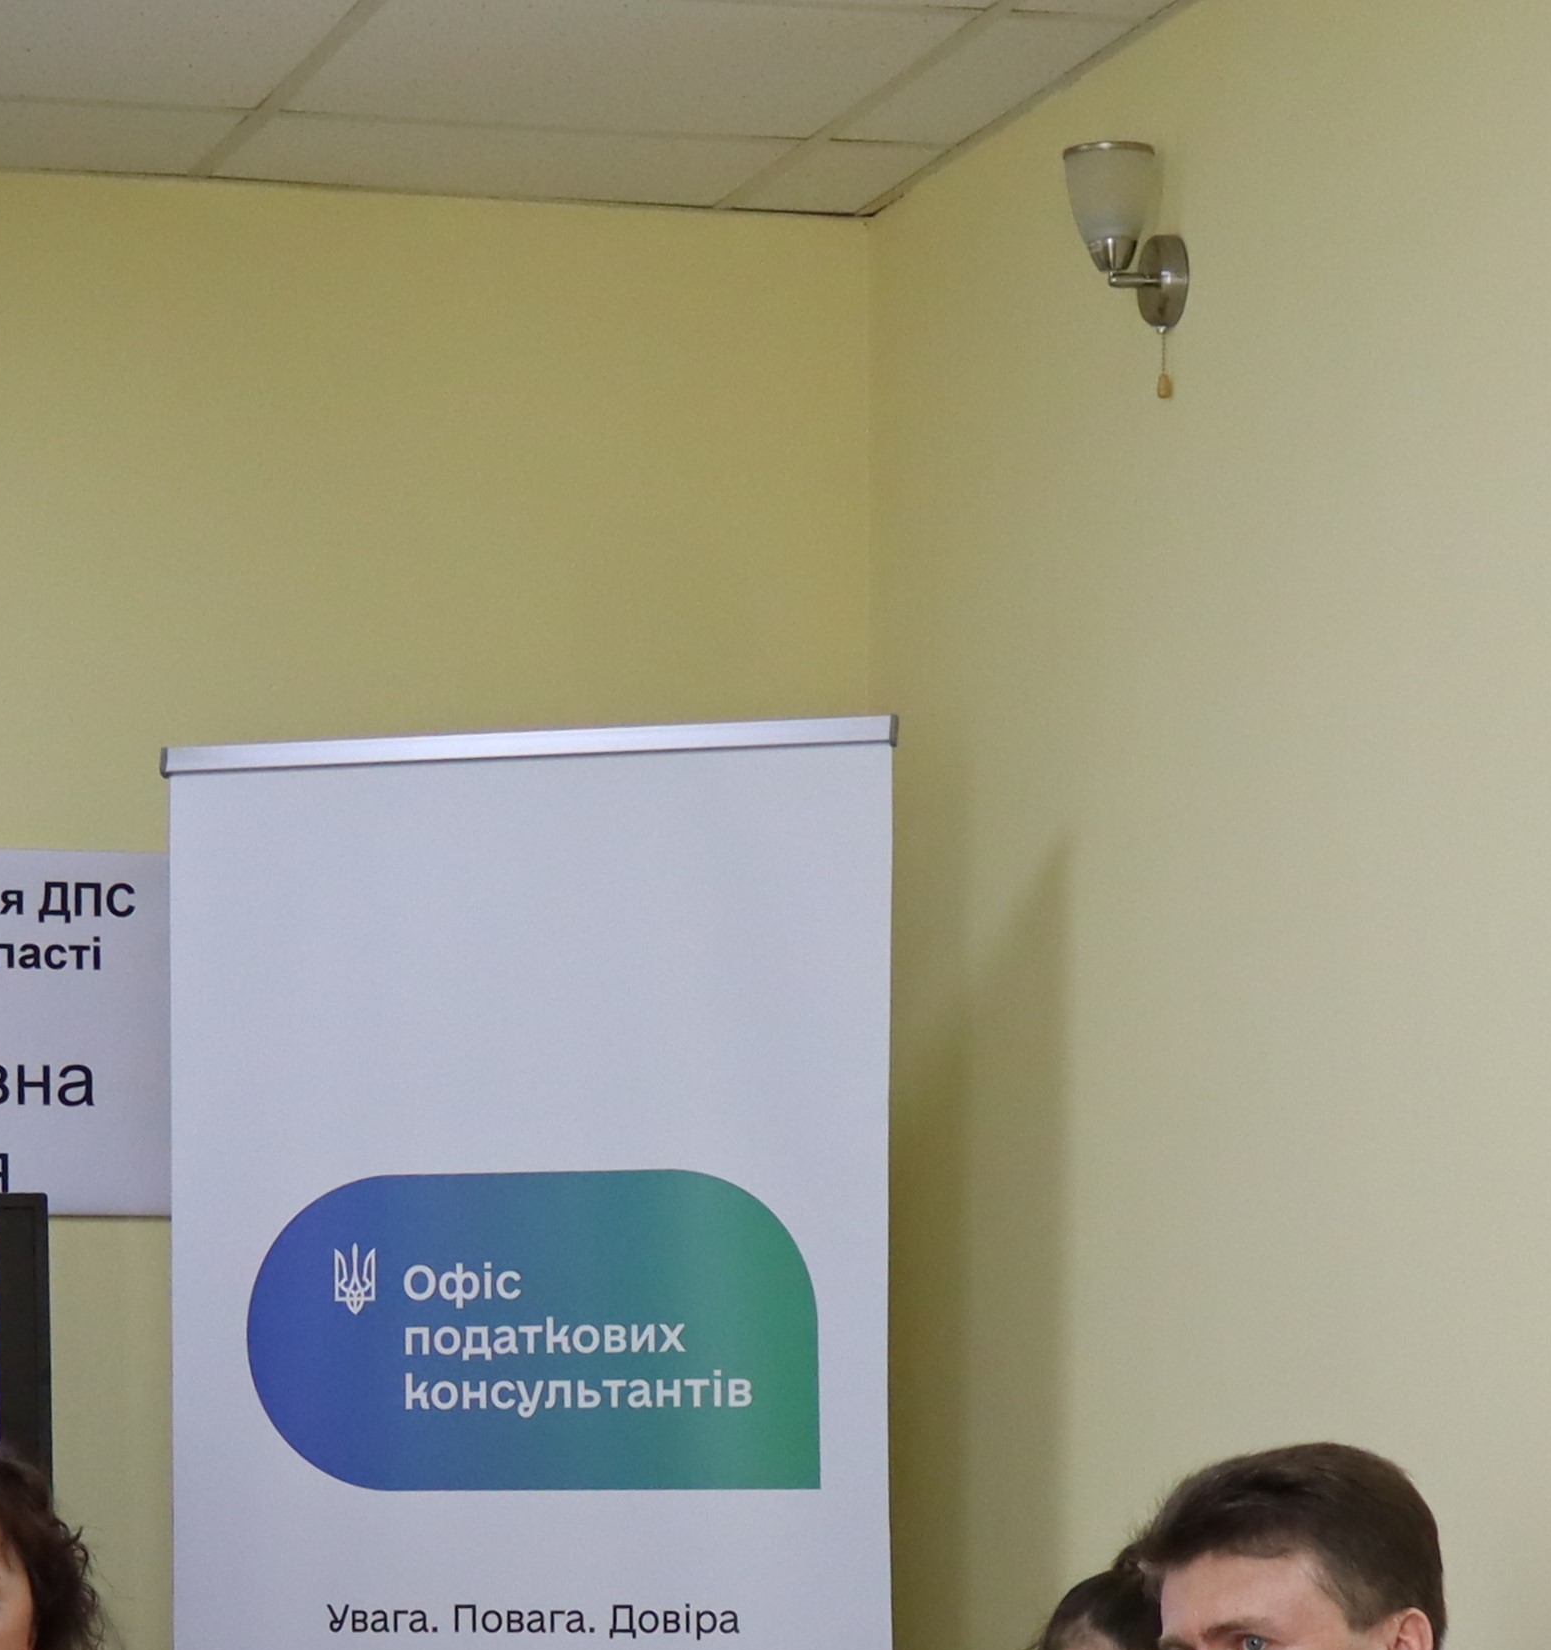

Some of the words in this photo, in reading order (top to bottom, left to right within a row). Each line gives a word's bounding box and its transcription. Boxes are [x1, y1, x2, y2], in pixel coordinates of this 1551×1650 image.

[37, 880, 136, 923] ДПС
[402, 1261, 522, 1309] Офіс
[403, 1316, 686, 1360] податкових
[403, 1369, 753, 1418] консультантів
[327, 1603, 439, 1634] Увага.
[452, 1603, 595, 1634] Повага.
[609, 1602, 740, 1640] Довіра
